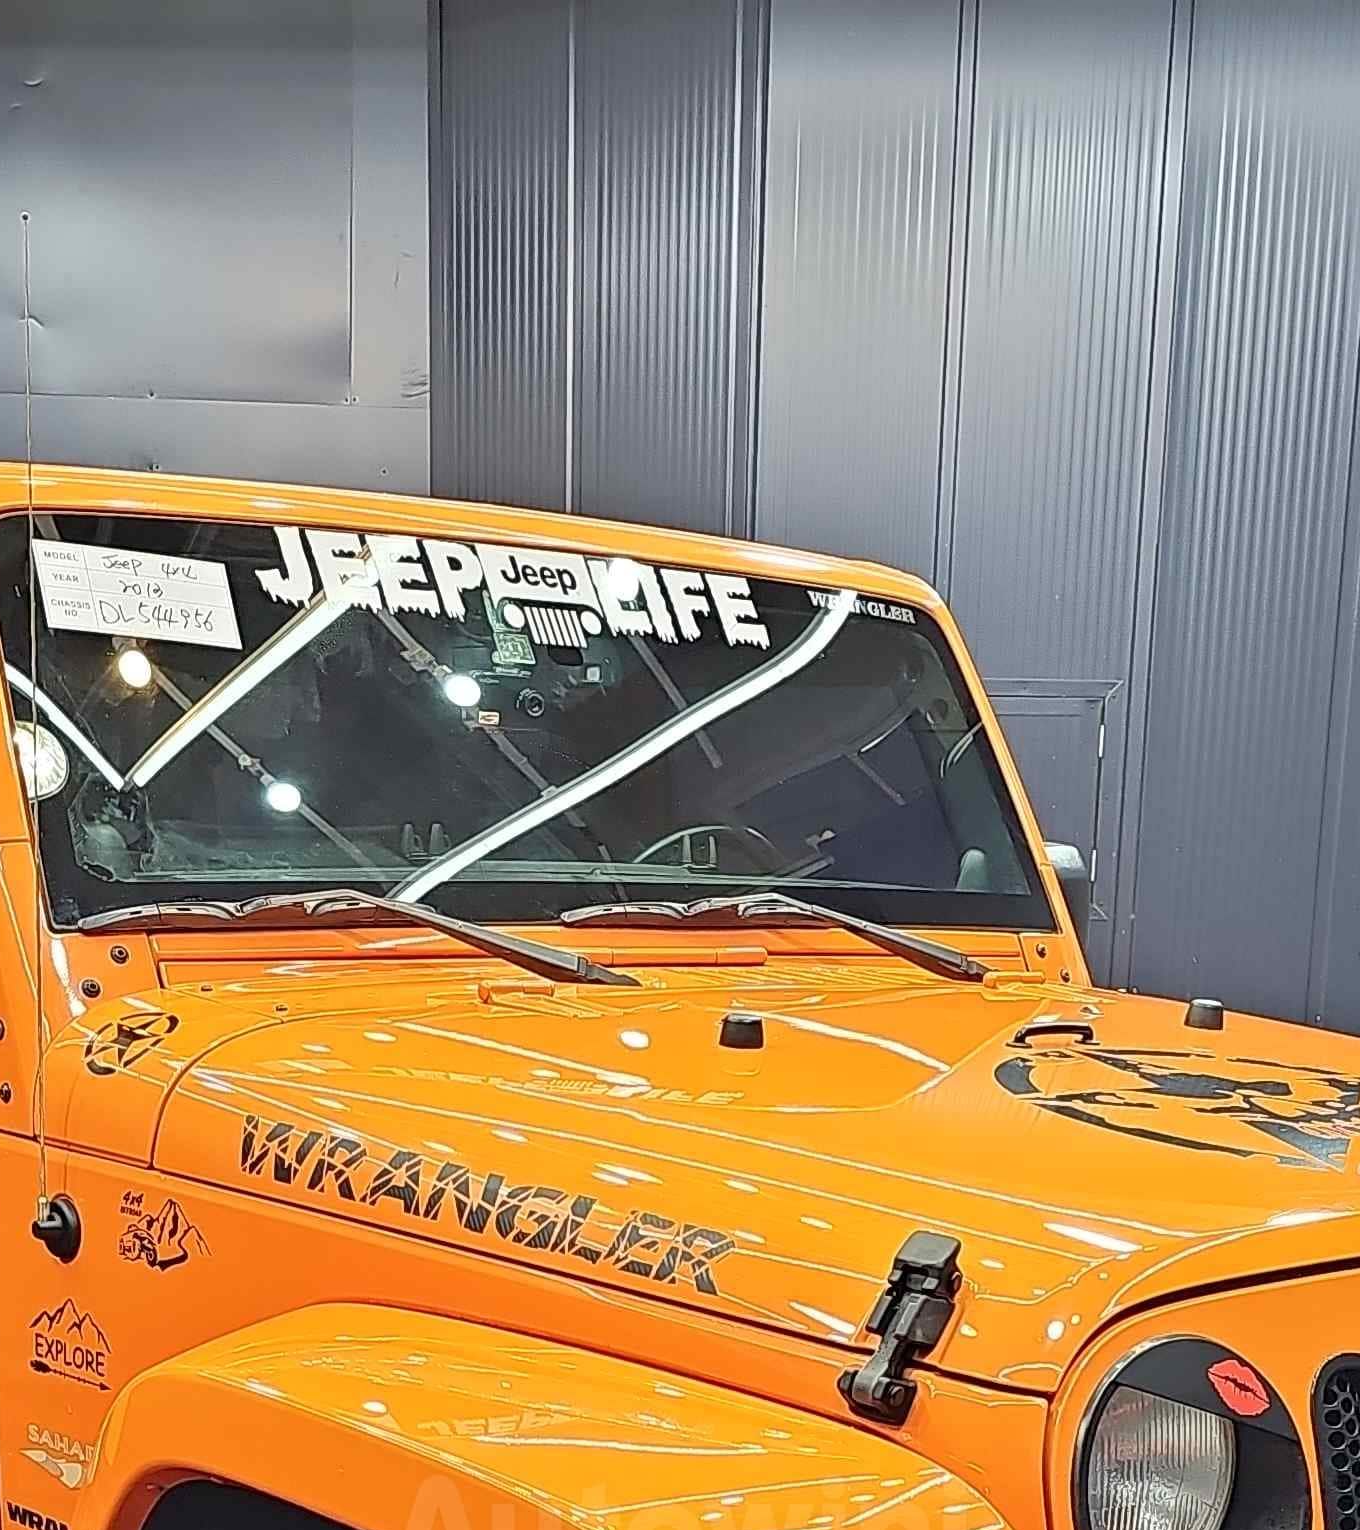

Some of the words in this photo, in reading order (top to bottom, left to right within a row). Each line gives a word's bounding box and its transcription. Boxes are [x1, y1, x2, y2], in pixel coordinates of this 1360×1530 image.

[43, 550, 80, 562] MODEL
[101, 553, 143, 576] Jeep
[51, 571, 80, 584] YEAR
[500, 554, 577, 596] Jeep
[255, 525, 486, 623] JEEP
[587, 556, 773, 650] LIFE
[50, 597, 91, 610] CHASSIS
[122, 1190, 145, 1208] 4x4
[240, 1113, 736, 1296] WRANGLER
[34, 1332, 105, 1377] EXPLORE
